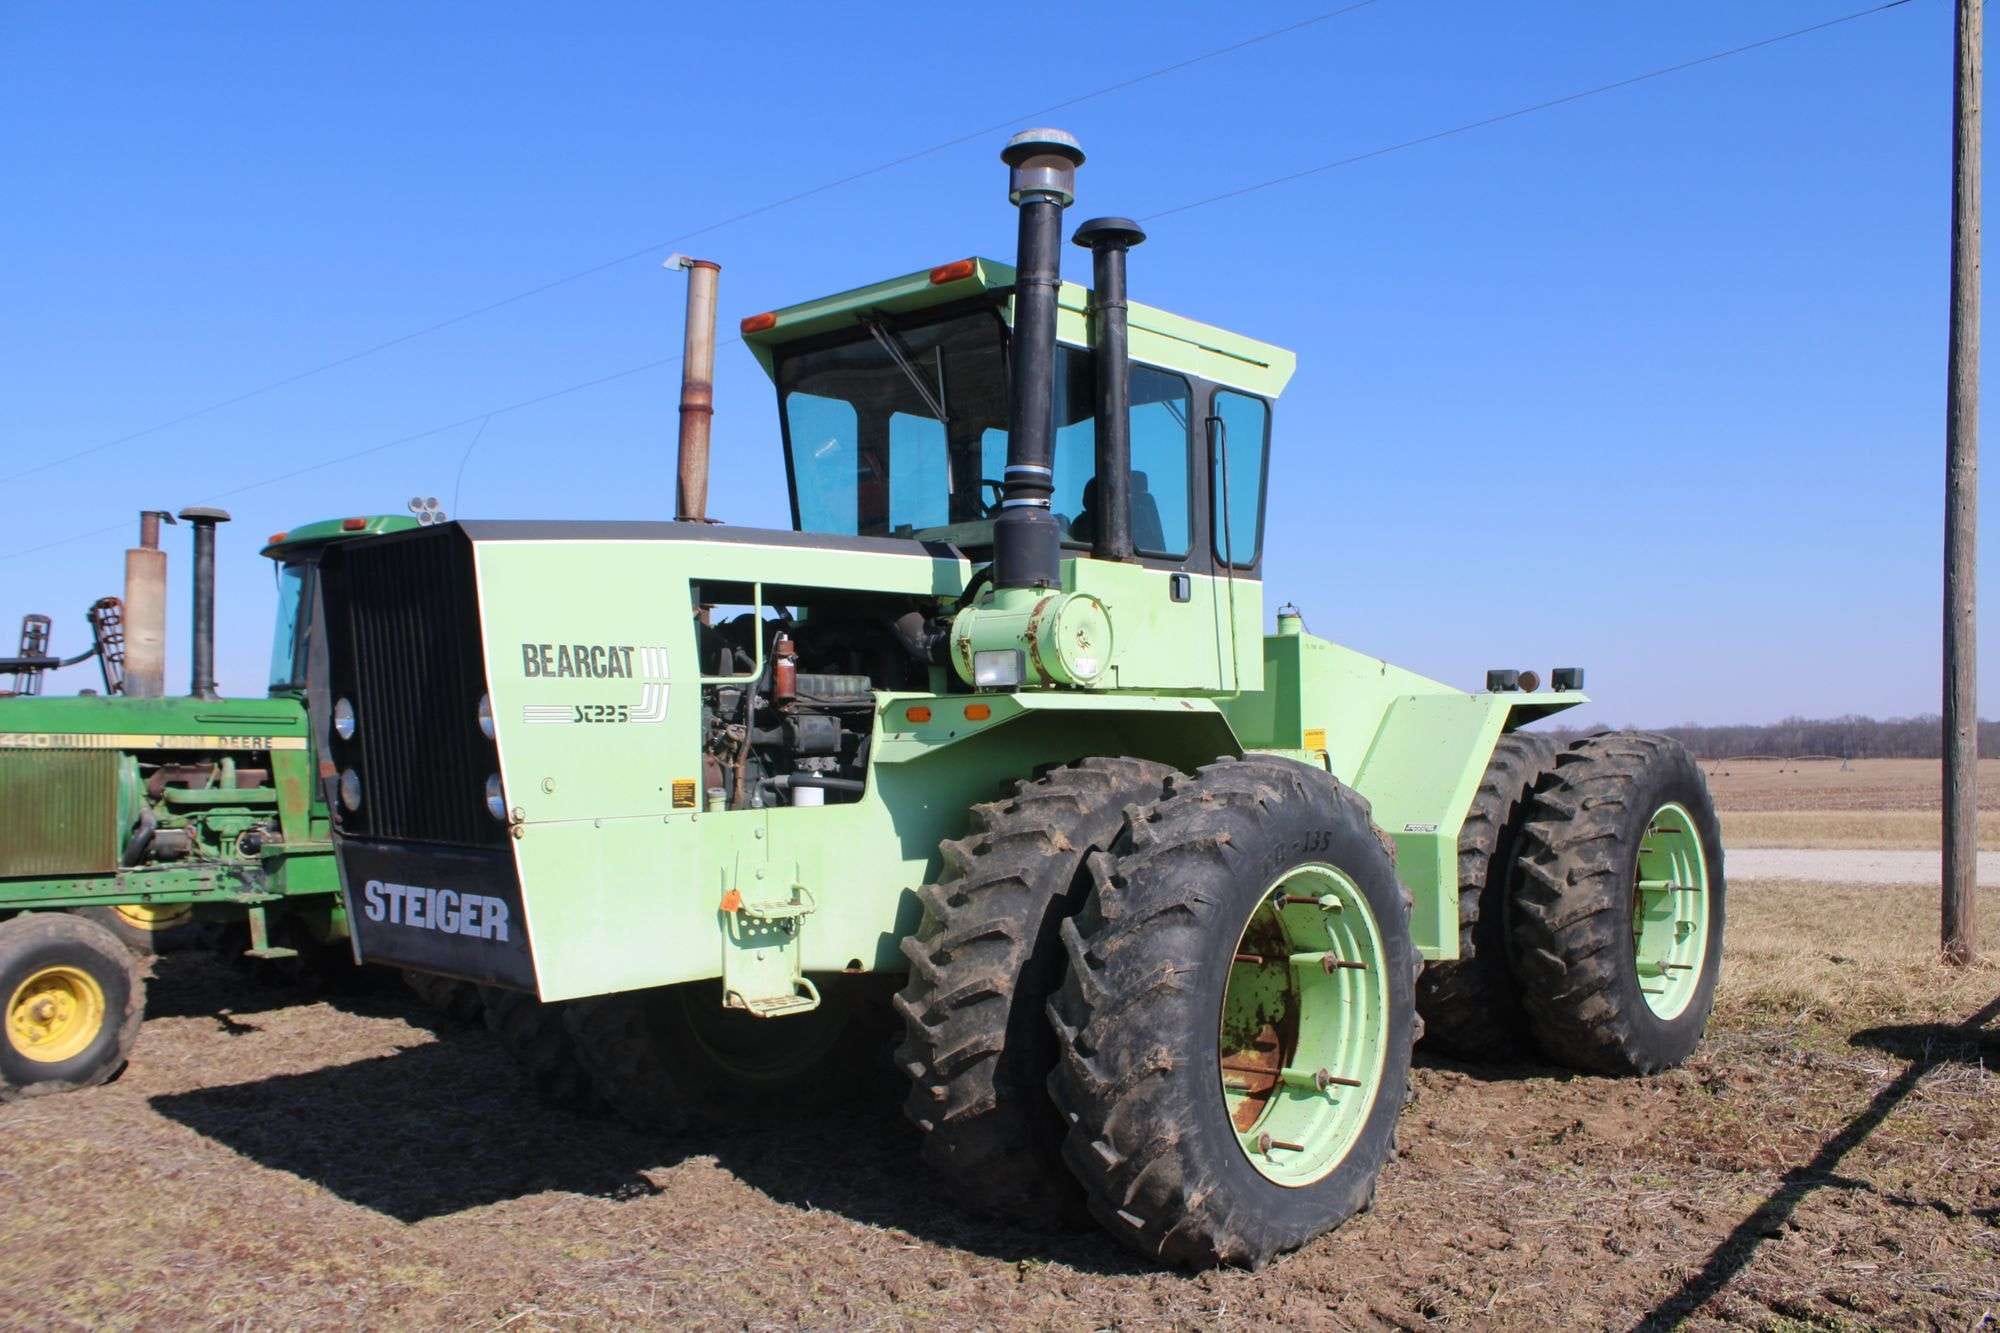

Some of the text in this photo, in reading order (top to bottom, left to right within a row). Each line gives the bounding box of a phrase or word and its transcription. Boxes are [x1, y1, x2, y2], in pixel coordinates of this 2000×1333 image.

[521, 643, 634, 678] BEARCAT
[218, 736, 273, 749] DEERE
[364, 880, 509, 942] STEIGER
